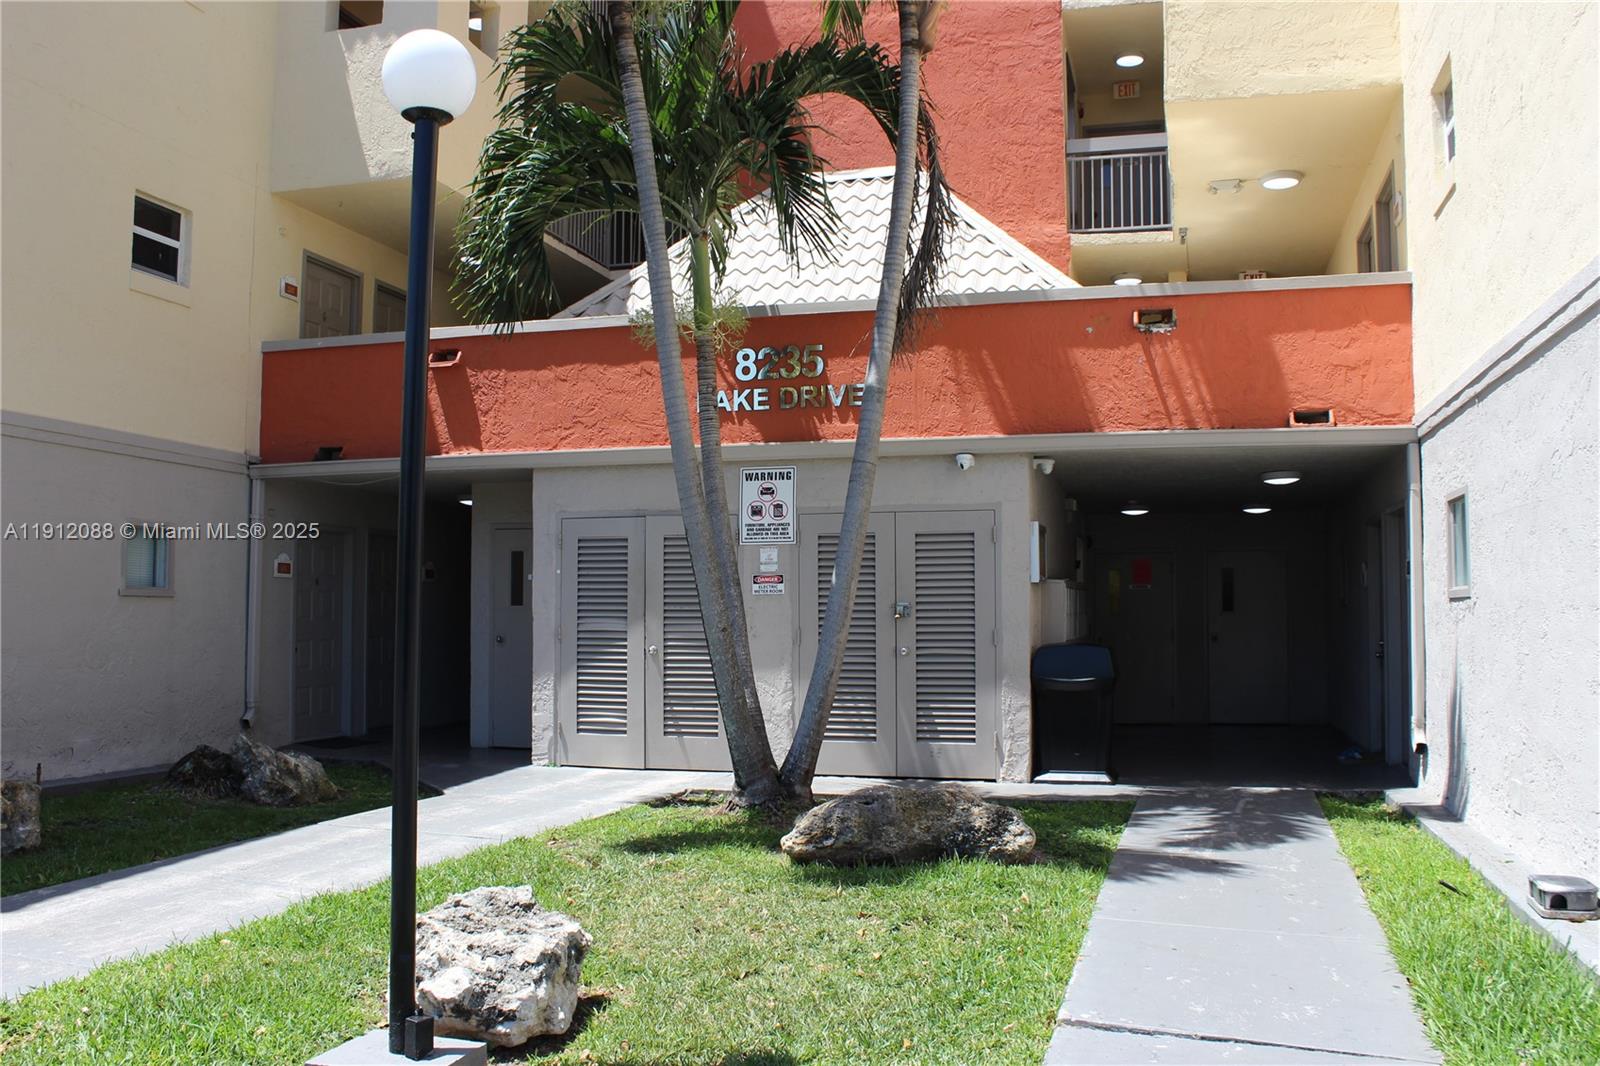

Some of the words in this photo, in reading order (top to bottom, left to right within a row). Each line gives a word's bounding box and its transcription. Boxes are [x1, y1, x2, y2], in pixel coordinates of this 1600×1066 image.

[1118, 84, 1136, 97] EXIT
[735, 344, 825, 382] 8235
[697, 388, 770, 413] AKE
[779, 383, 866, 410] DRIVE
[744, 471, 792, 482] WARNING
